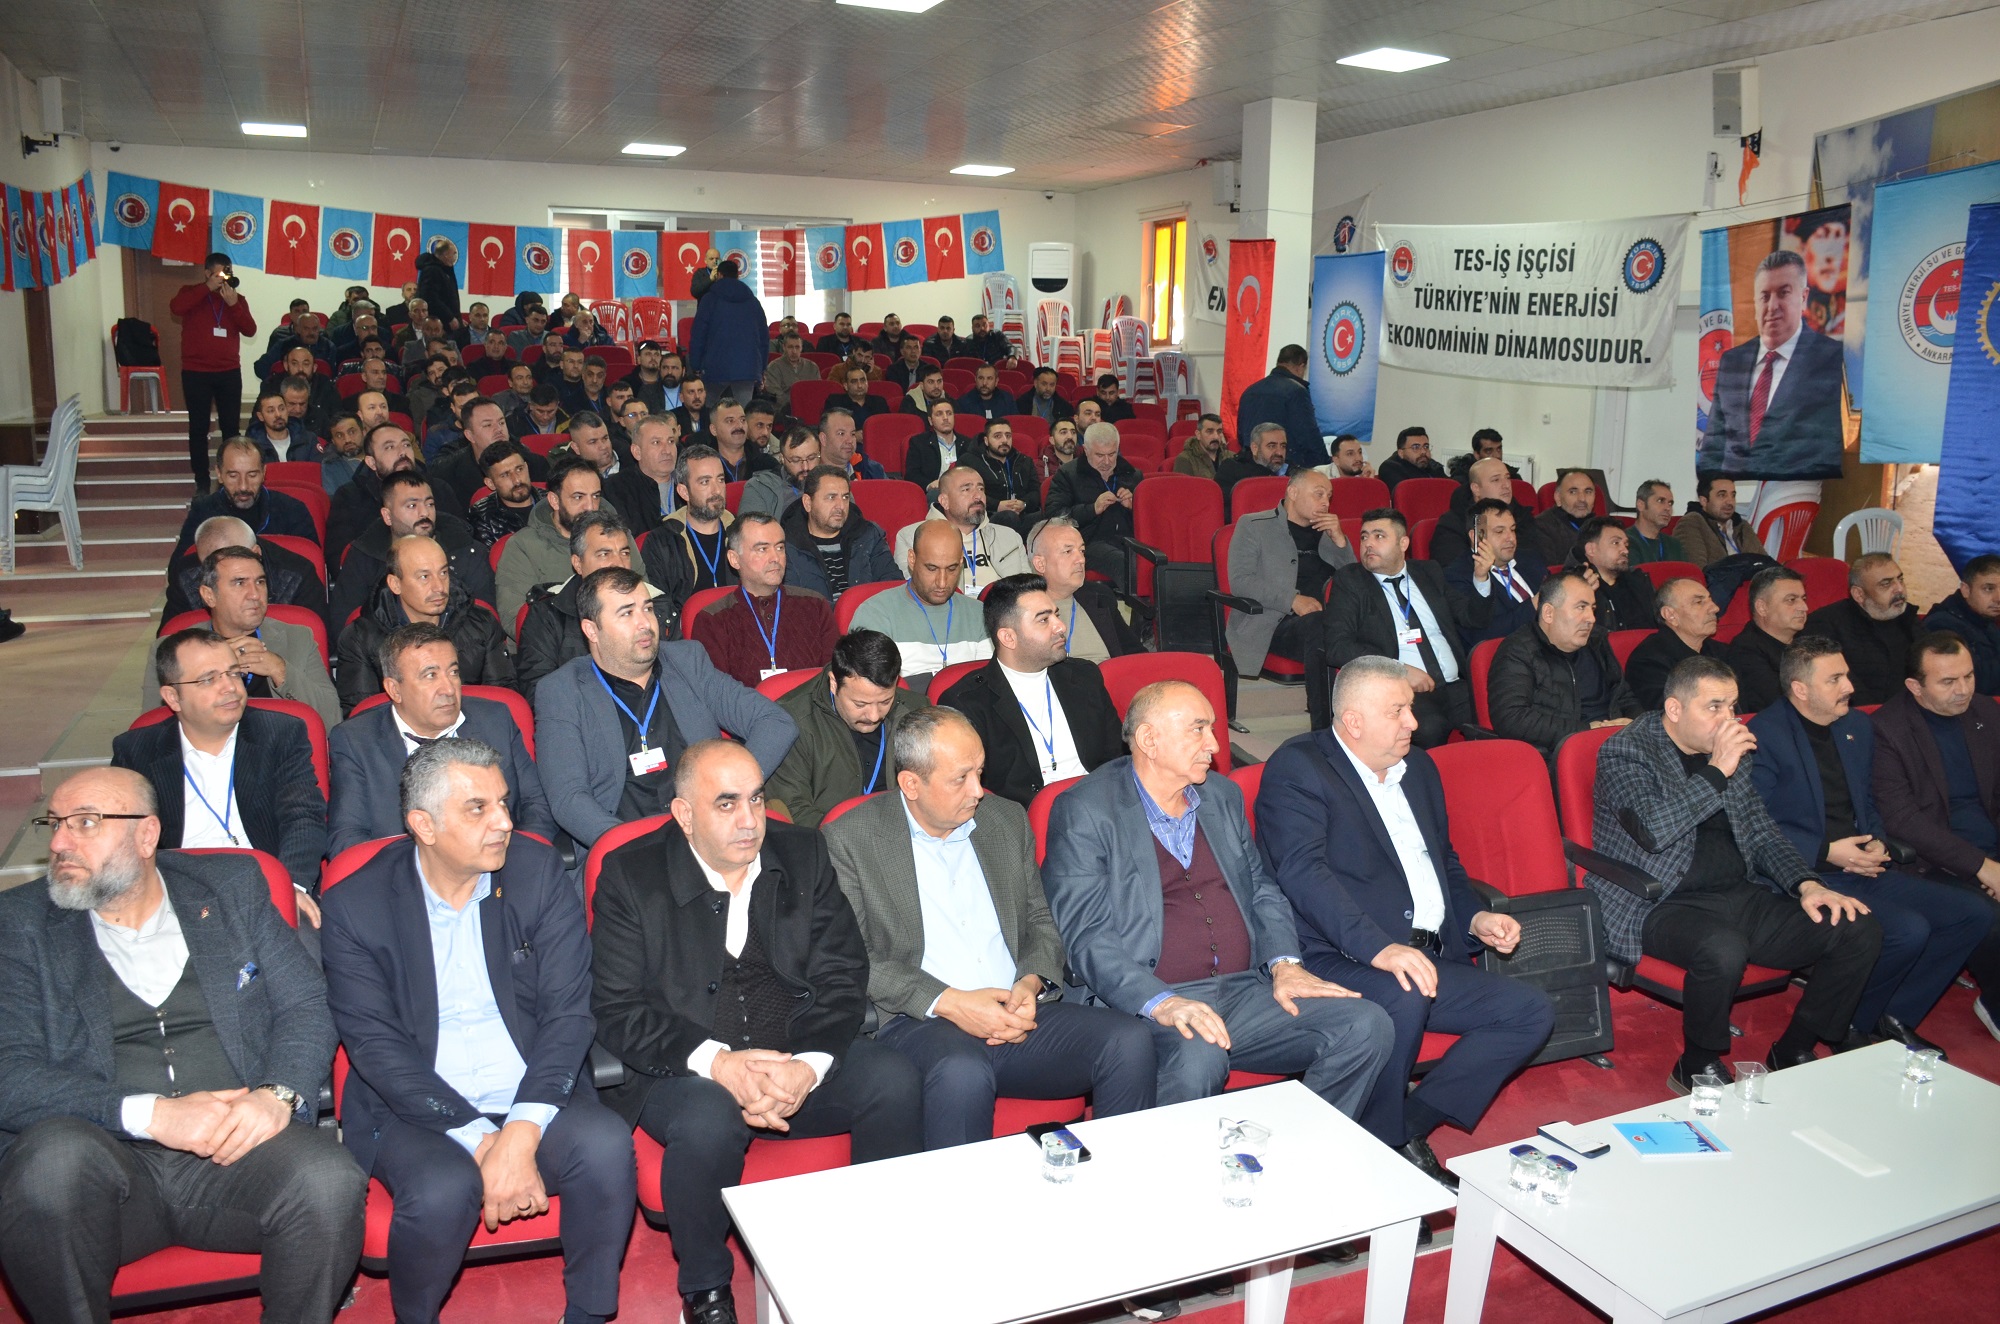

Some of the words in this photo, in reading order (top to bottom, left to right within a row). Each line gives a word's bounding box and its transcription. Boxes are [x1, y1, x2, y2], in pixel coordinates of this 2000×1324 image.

[1454, 243, 1511, 279] TES-İŞ
[1516, 242, 1576, 279] İŞÇİSİ
[1941, 248, 1953, 259] VE
[1414, 283, 1521, 316] TÜRKİYE'NİN
[1527, 286, 1618, 318] ENERJİSİ
[1388, 323, 1489, 355] EKONOMİNİN
[1495, 329, 1652, 364] DİNAMOSUDUR.
